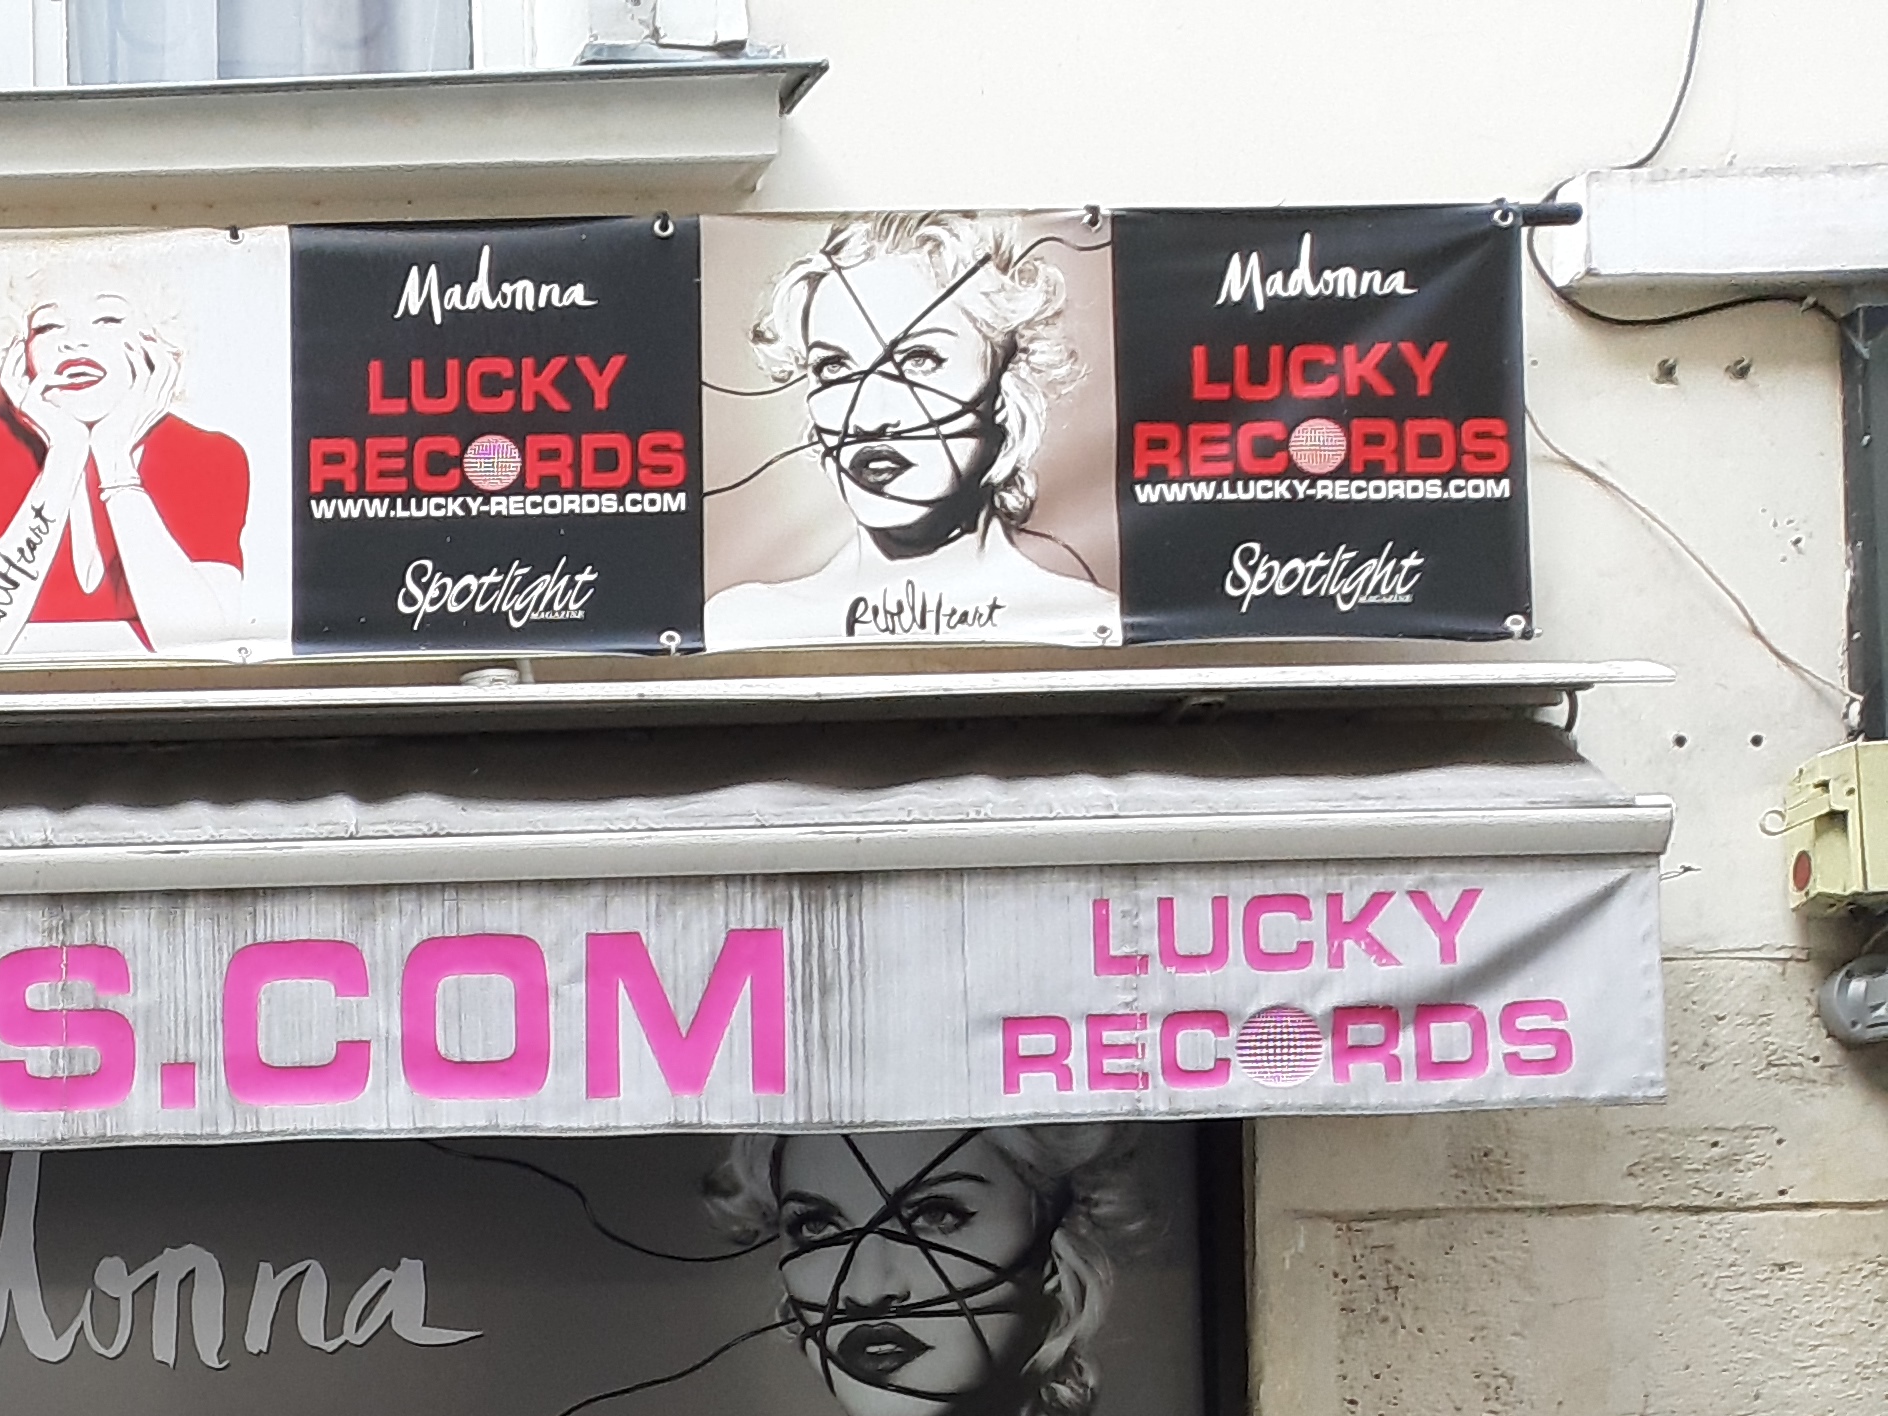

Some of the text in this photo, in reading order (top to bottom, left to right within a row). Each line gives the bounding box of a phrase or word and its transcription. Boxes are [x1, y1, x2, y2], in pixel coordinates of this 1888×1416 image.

[394, 245, 597, 324] Madonna
[1216, 233, 1417, 310] Madonna
[369, 355, 626, 415] LUCKY
[1192, 342, 1448, 401] LUCKY
[310, 432, 687, 493] RECORDS
[1134, 419, 1510, 478] RECORDS
[311, 493, 686, 518] WWW.LUCKY-RECORDS.COM
[1135, 479, 1510, 503] WWW.LUCKY-RECORDS.COM
[398, 556, 598, 630] Spotlight
[1225, 542, 1424, 612] Spotlight
[1094, 889, 1480, 975] LUCKY
[1003, 1001, 1573, 1094] RECORDS
